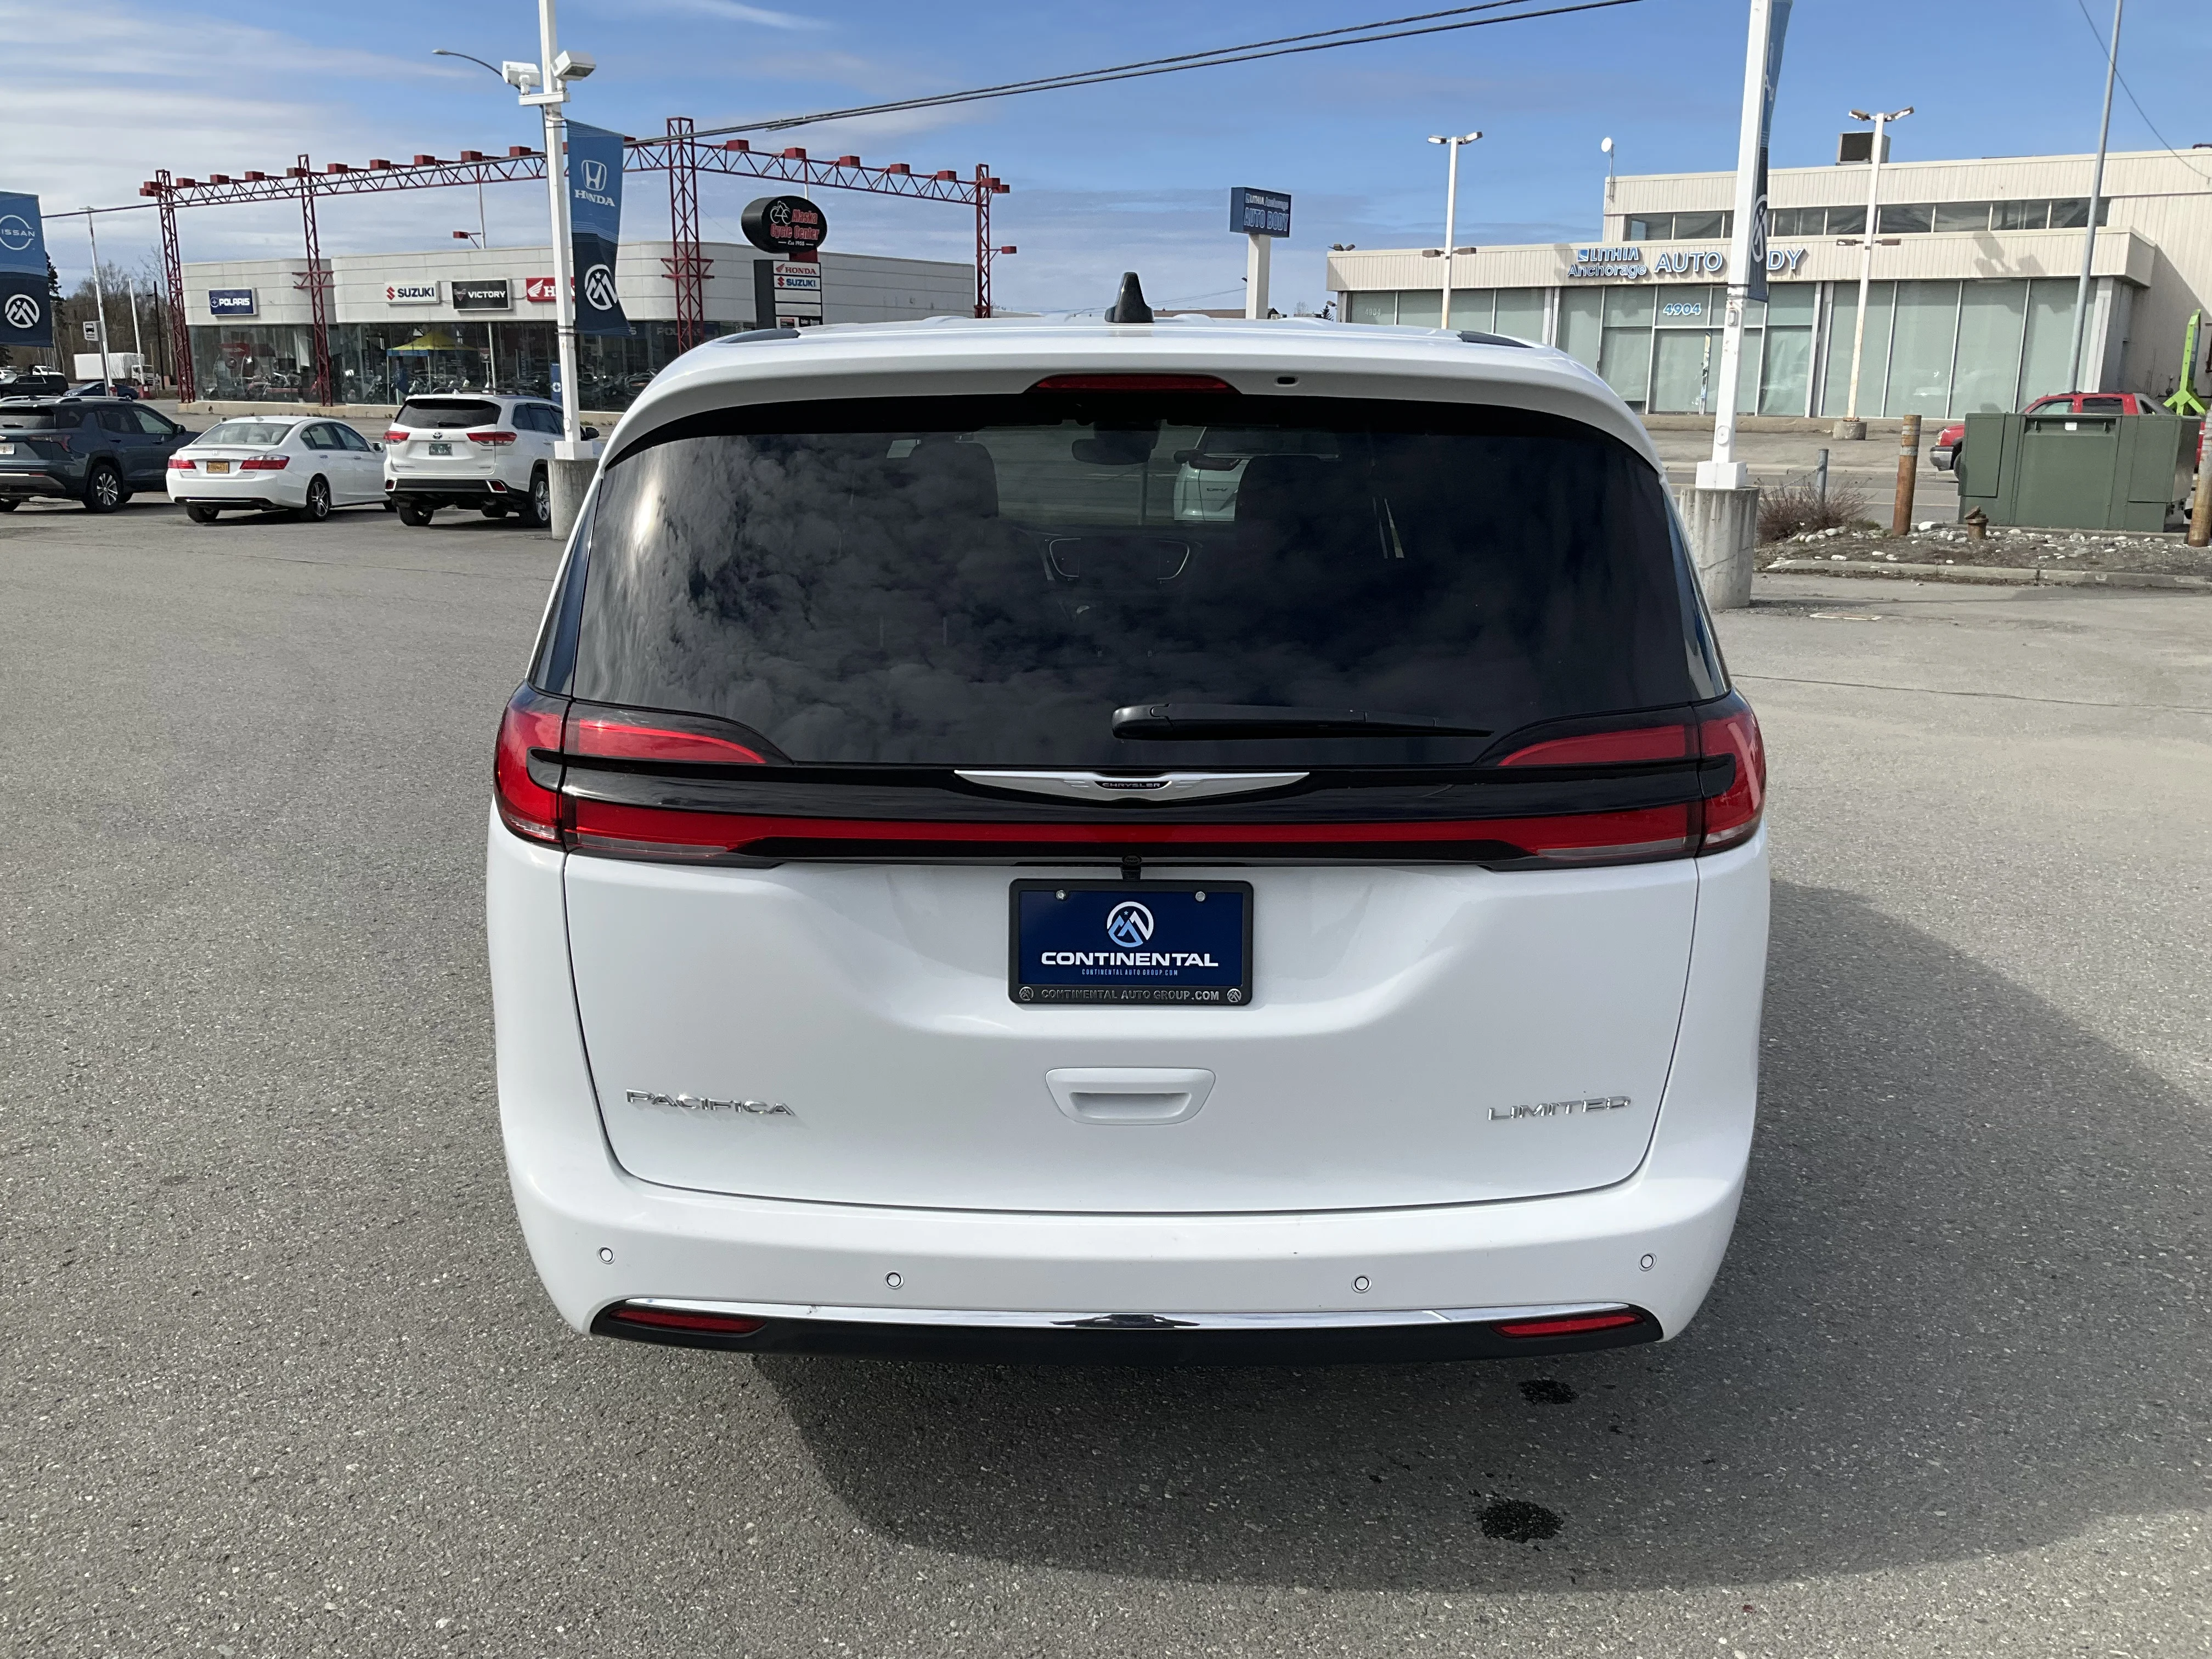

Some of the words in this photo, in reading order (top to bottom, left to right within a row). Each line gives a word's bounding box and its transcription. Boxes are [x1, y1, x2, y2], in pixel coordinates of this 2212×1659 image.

[574, 189, 616, 207] HONDA
[1250, 195, 1264, 205] LITHIA
[791, 209, 818, 224] Alaska
[1244, 207, 1266, 228] AUTO
[1267, 211, 1289, 232] BODY
[0, 229, 35, 237] ISSAN
[770, 223, 793, 239] Cycle
[794, 225, 820, 240] Center
[1590, 247, 1639, 261] LITHIA
[1654, 251, 1723, 273] AUTO
[1767, 248, 1804, 270] DY
[1567, 263, 1647, 279] Anchorage
[786, 278, 816, 287] SUZUKI
[397, 287, 435, 298] SUZUKI
[467, 290, 506, 299] VICTORY
[219, 298, 250, 306] POLARIS
[1663, 303, 1702, 316] 4904
[1041, 952, 1219, 967] CONTINENTAL
[1041, 989, 1118, 1000] CONTINENTAL
[1121, 990, 1151, 1000] AUTO
[626, 1088, 795, 1116] PACIFICA
[1487, 1095, 1632, 1121] LIMITED
